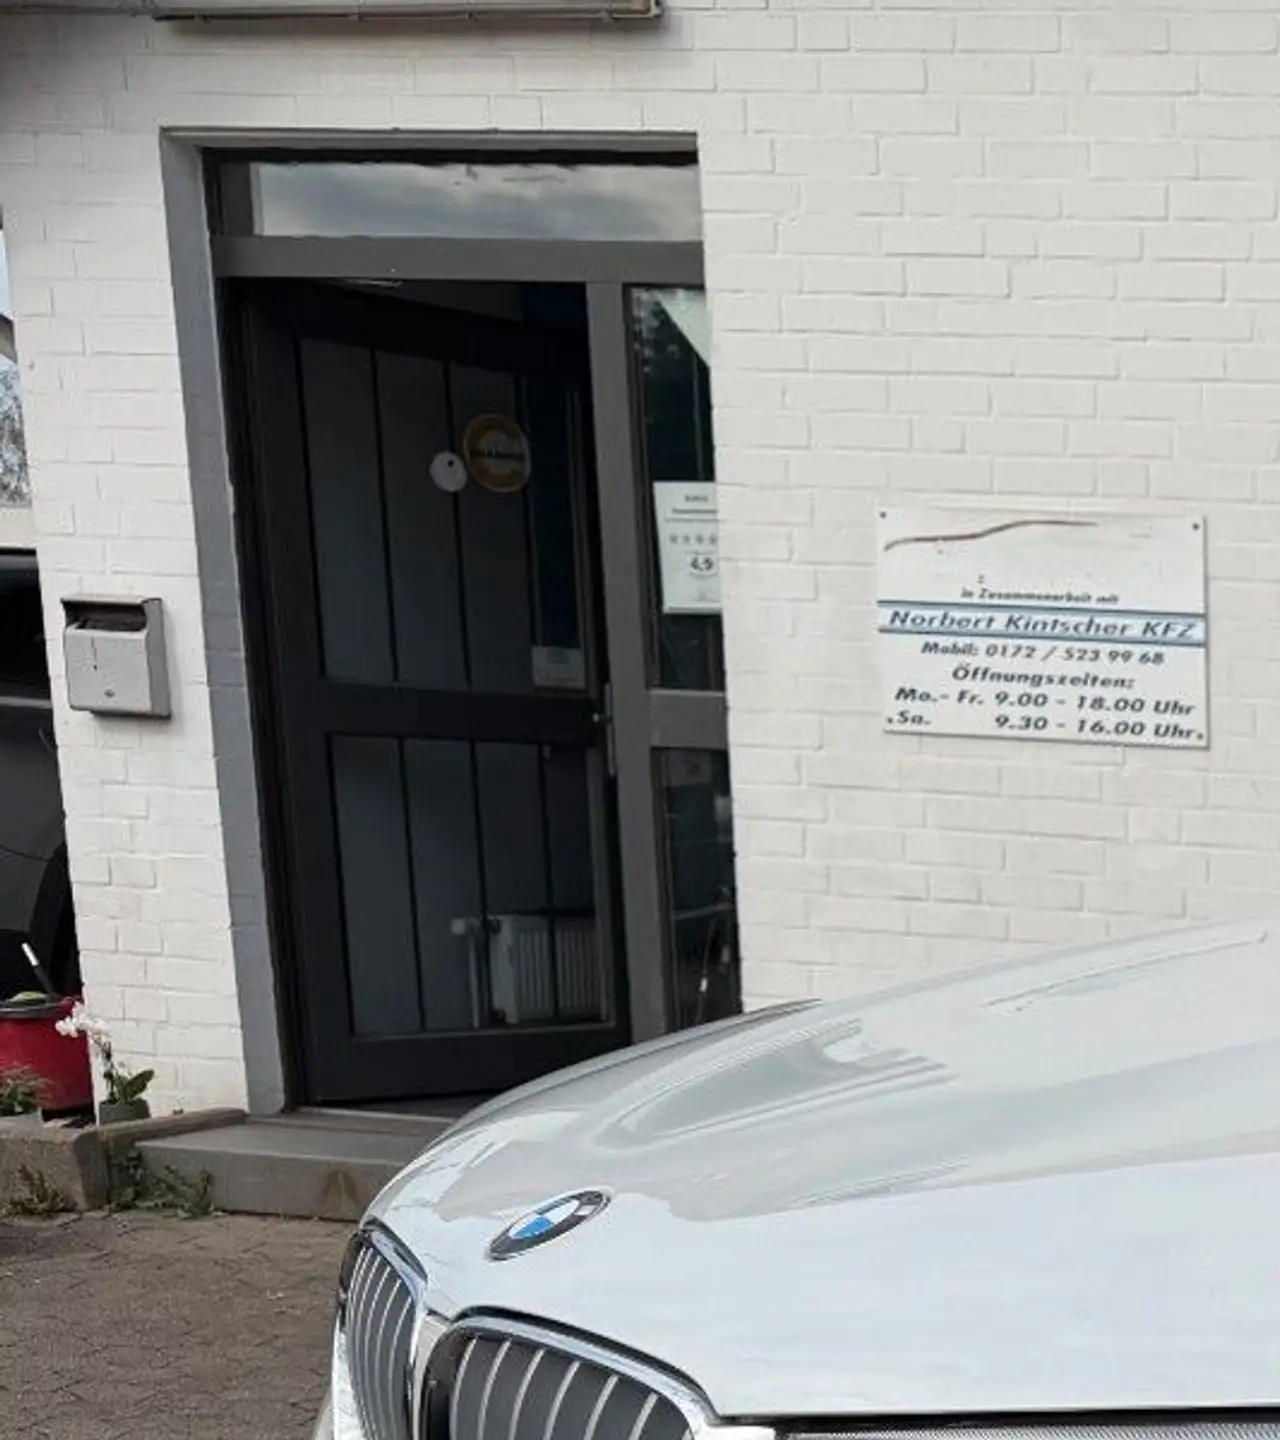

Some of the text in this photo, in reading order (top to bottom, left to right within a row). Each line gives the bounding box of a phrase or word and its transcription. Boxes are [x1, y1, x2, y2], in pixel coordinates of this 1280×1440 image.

[889, 609, 1197, 638] Norbert Kintscher KFZ
[921, 641, 1165, 665] Mobil: 0172 / 523 99 68
[951, 662, 1135, 689] Öffnungszeiten:
[956, 689, 984, 705] Fr.
[995, 691, 1048, 707] 9.00
[1077, 696, 1145, 712] 18.00
[1154, 700, 1195, 715] Uhr
[897, 710, 931, 726] Sa.
[995, 715, 1048, 731] 9.30
[1077, 719, 1145, 736] 16.00
